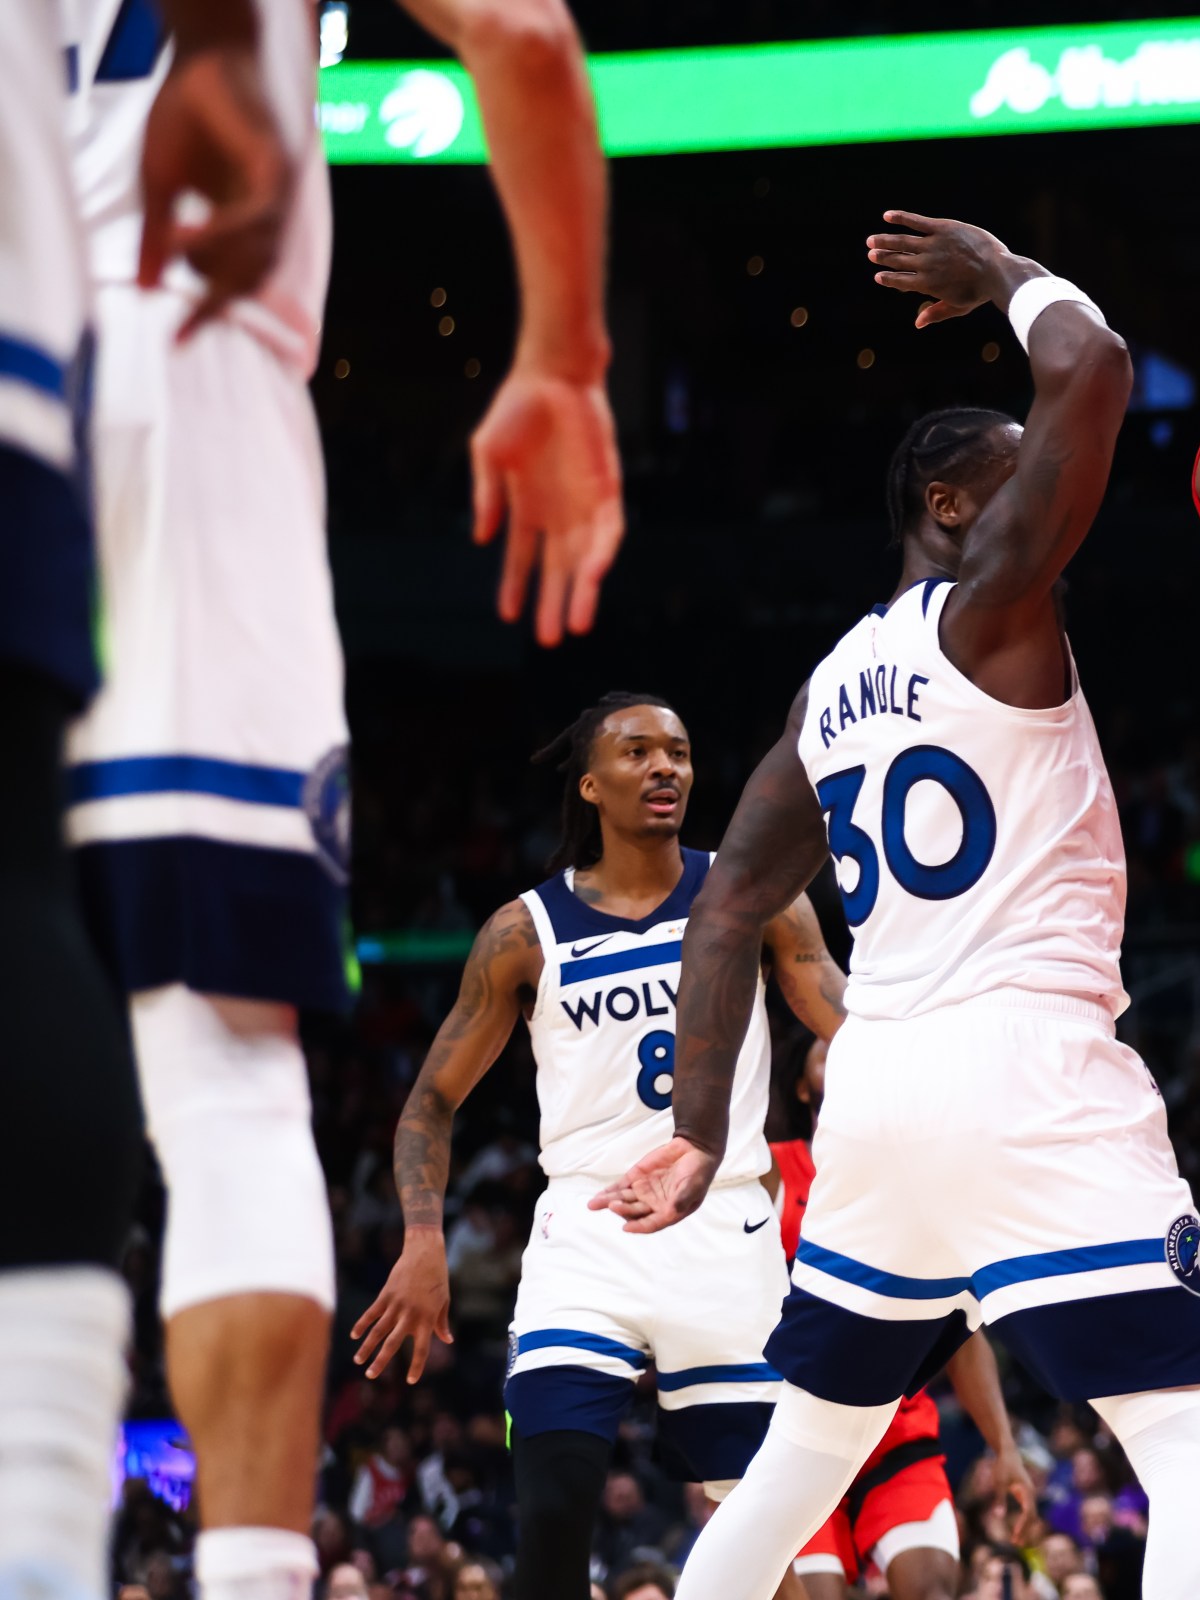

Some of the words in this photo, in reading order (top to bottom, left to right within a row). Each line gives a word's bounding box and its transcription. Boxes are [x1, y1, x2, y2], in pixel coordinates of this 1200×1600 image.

[819, 664, 930, 750] RANDLE
[815, 744, 997, 928] 30
[637, 1029, 676, 1111] 8
[1168, 1217, 1190, 1271] MINNESOTA
